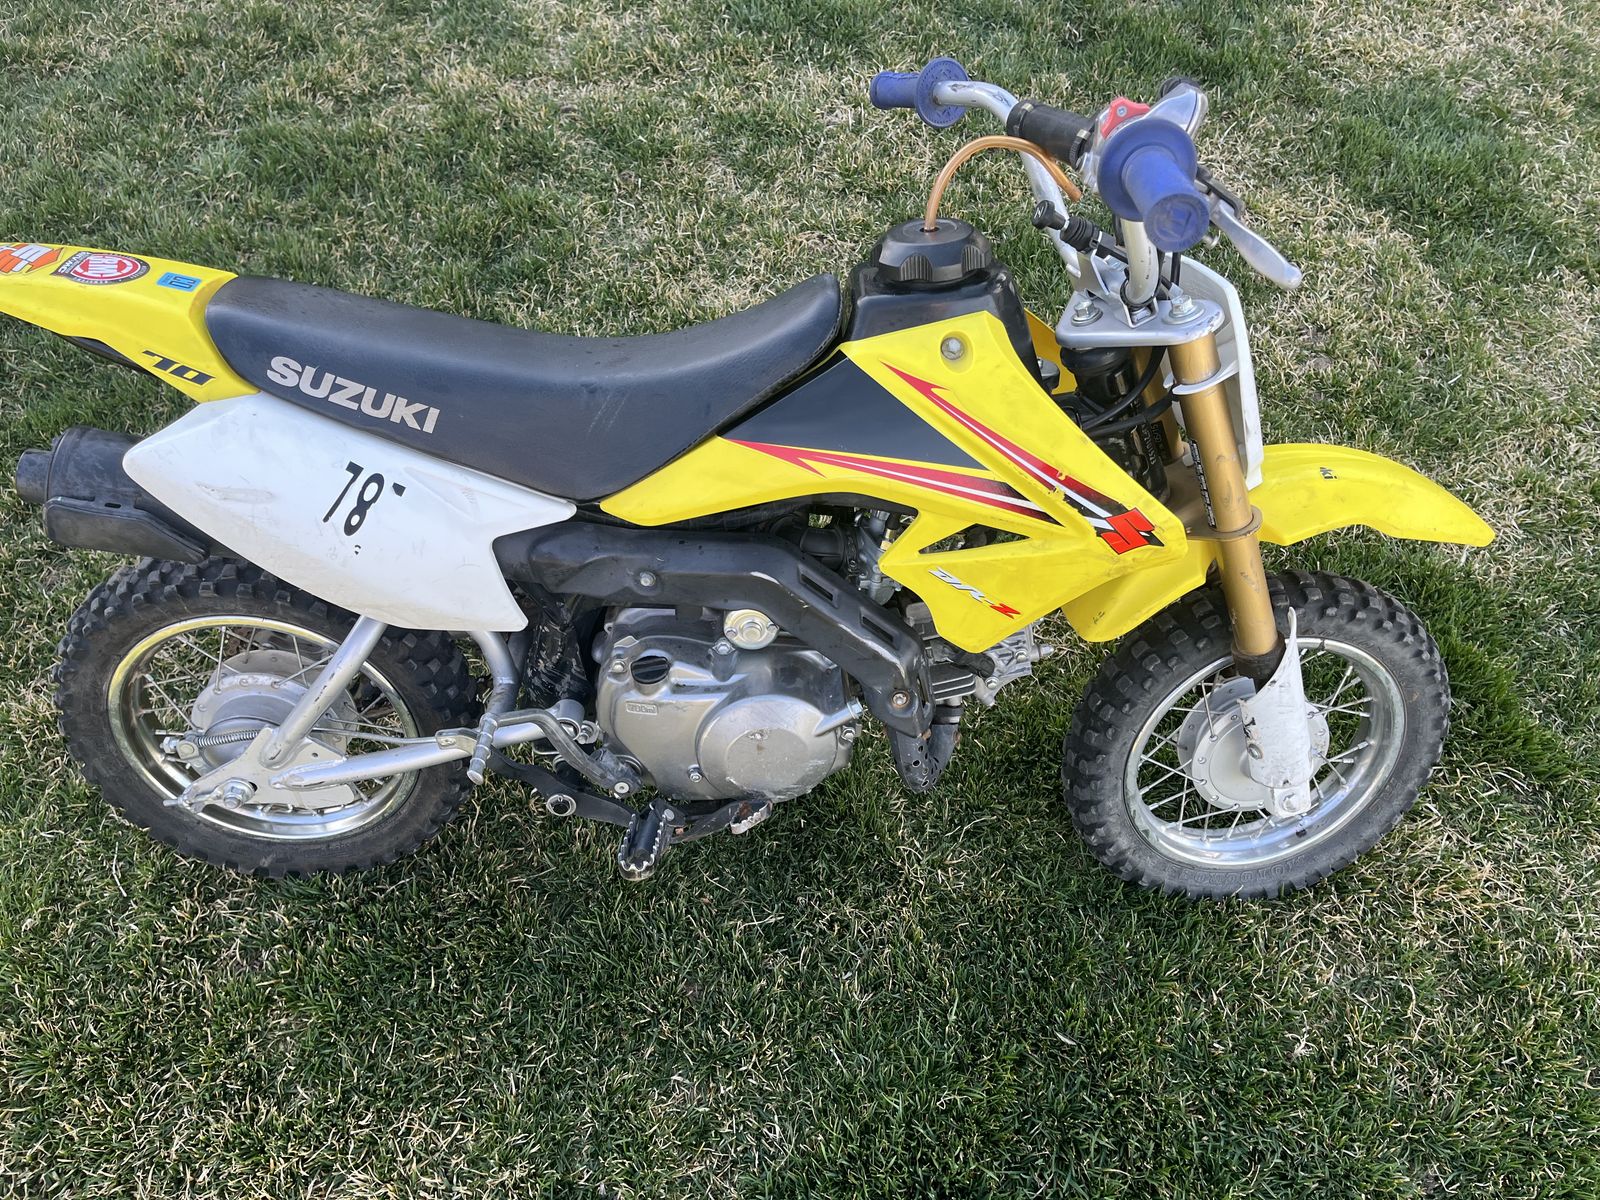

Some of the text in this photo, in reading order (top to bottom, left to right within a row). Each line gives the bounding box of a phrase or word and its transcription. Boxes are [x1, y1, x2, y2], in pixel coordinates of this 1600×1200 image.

[142, 350, 216, 386] 70
[266, 356, 441, 434] SUZUKI
[322, 460, 385, 537] 78
